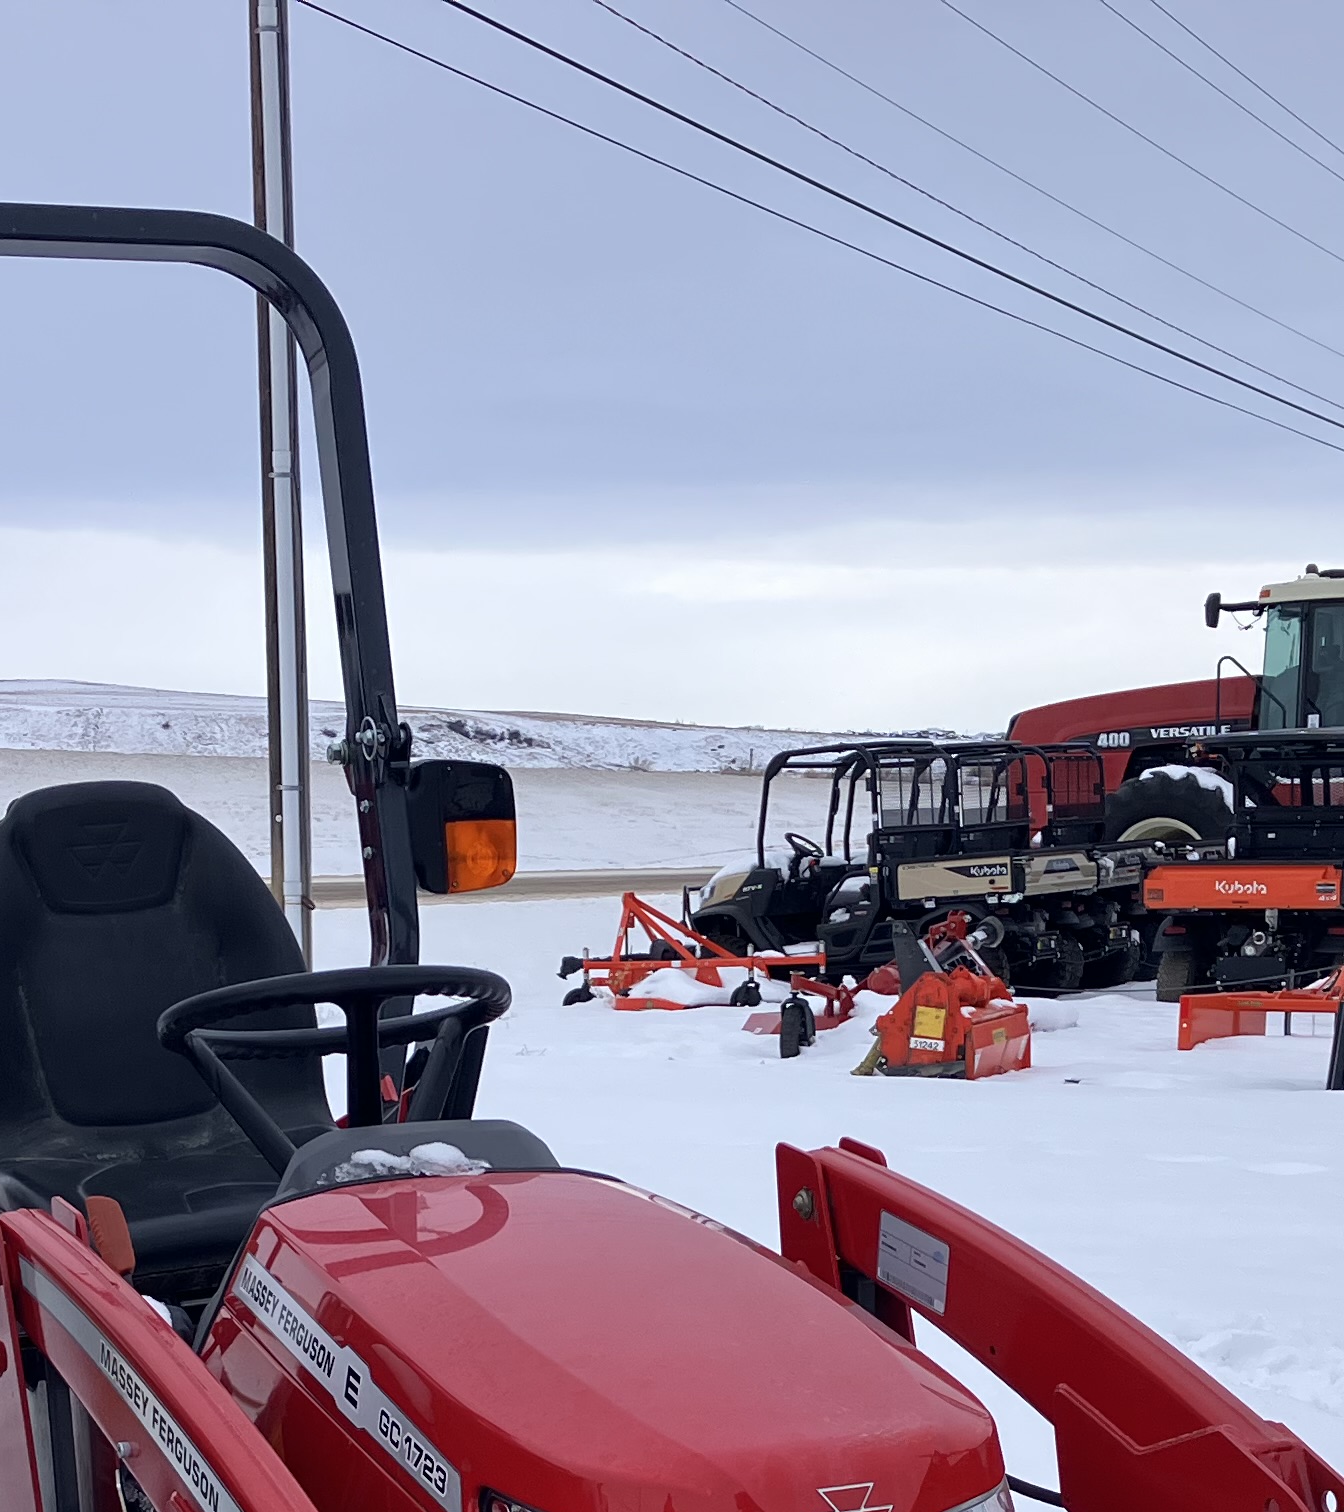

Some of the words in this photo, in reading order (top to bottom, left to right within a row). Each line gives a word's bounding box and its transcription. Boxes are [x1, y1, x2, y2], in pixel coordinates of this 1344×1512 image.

[1097, 732, 1131, 748] 400
[1150, 725, 1231, 739] VERSATILE
[970, 864, 1007, 877] Kubota
[1215, 880, 1268, 895] Kubota
[239, 1267, 280, 1319] MASSEY
[278, 1303, 336, 1379] FERGUSON
[344, 1365, 362, 1409] E
[100, 1342, 149, 1416] MASSEY
